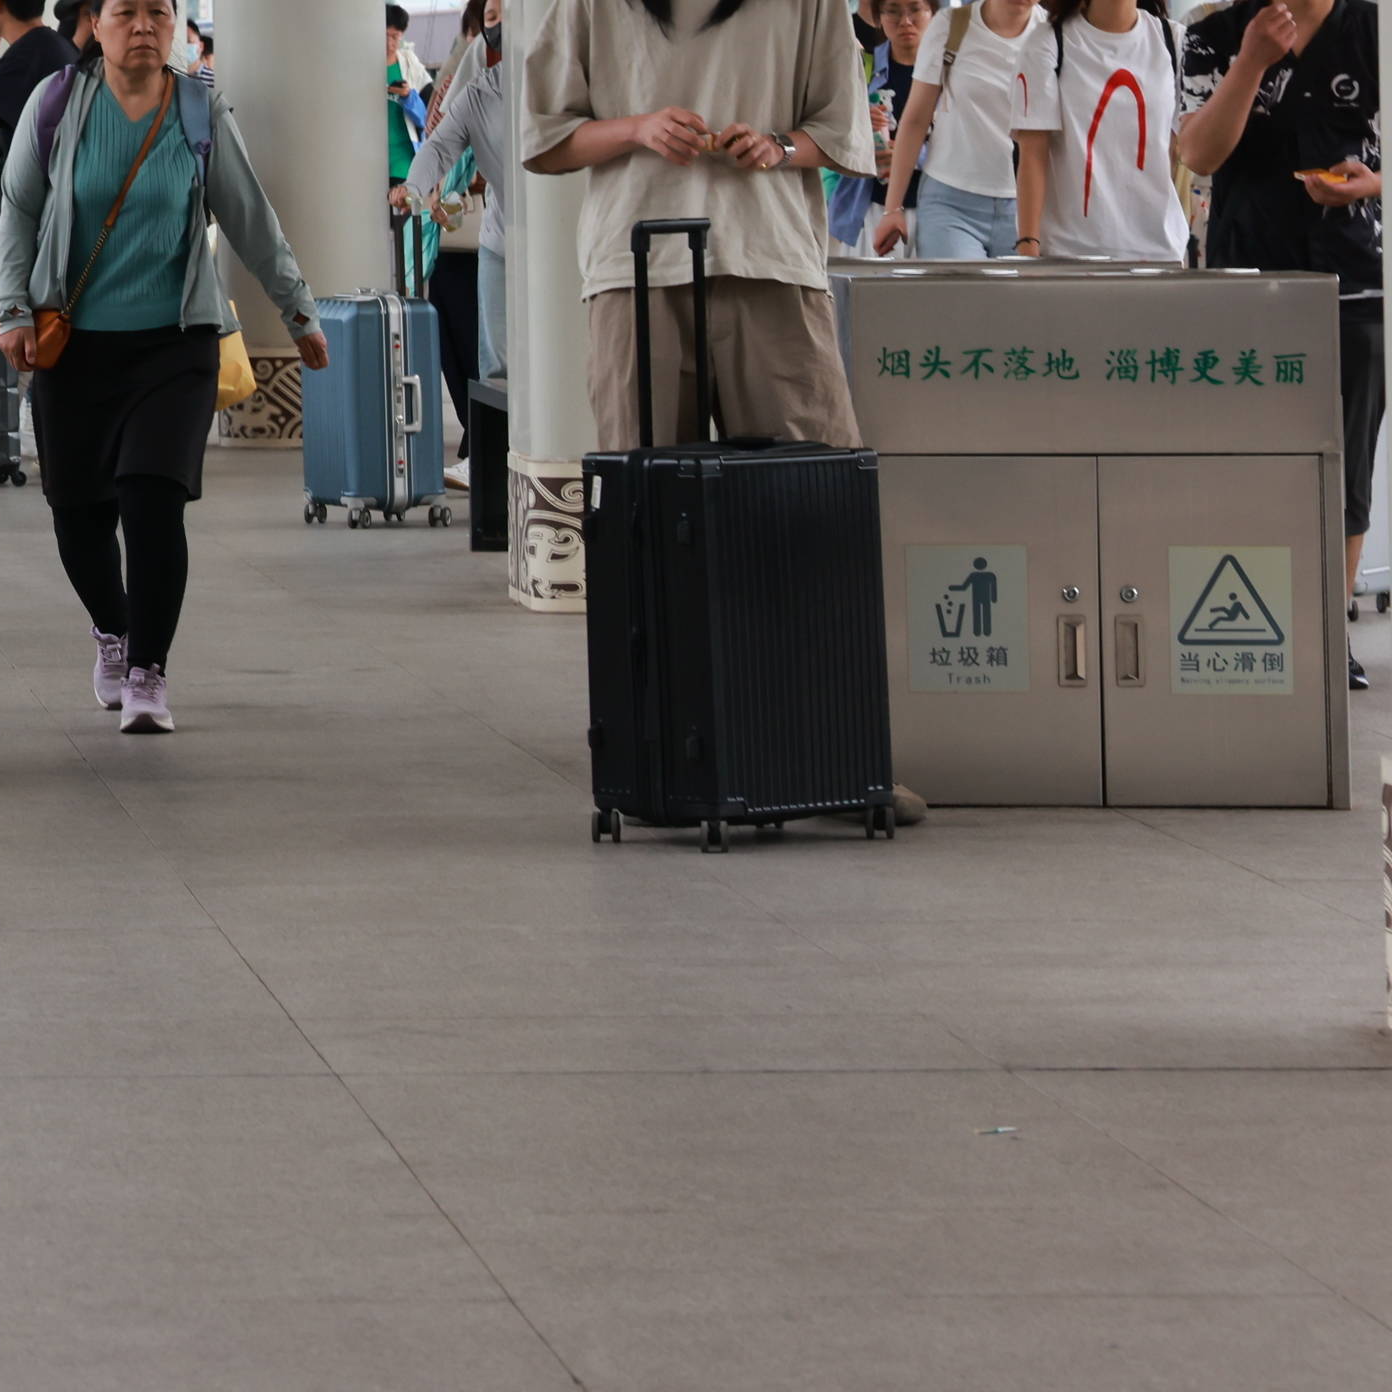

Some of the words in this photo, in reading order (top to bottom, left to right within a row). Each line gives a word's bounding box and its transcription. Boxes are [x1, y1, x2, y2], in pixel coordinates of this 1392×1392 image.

[876, 345, 1080, 382] 烟头不落地
[1105, 346, 1308, 386] 淄博更美丽
[929, 646, 1008, 667] 垃圾箱
[1180, 652, 1284, 672] 当心滑倒
[947, 672, 991, 685] Trash
